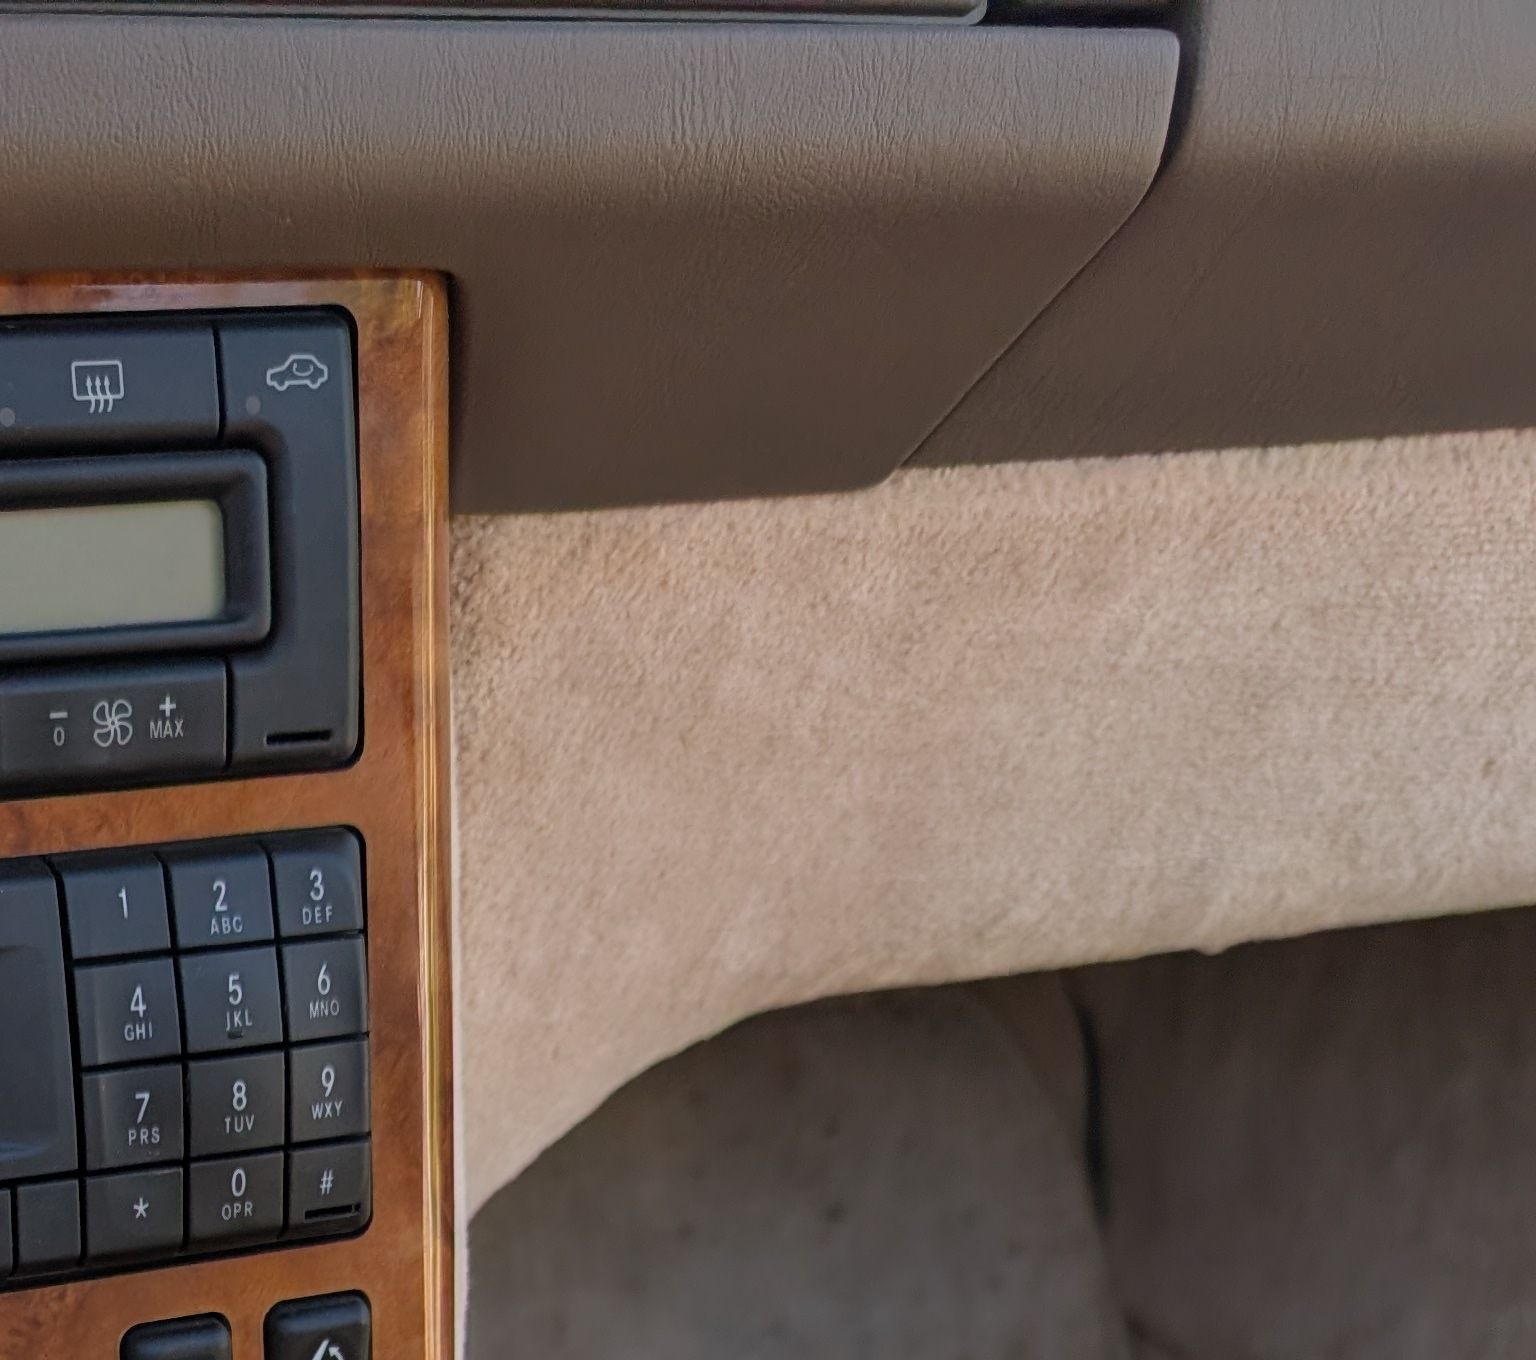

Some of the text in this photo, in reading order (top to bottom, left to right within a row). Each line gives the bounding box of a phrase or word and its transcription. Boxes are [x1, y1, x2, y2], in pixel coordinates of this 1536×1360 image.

[149, 719, 184, 739] MAX
[213, 880, 228, 912] 2
[309, 869, 324, 901] 3
[118, 886, 129, 919] 1
[210, 917, 243, 935] ABC
[302, 906, 333, 925] DEF
[228, 973, 243, 1005] 5
[317, 962, 331, 995] 6
[130, 984, 147, 1018] 4
[309, 1000, 340, 1019] MNO
[124, 1022, 153, 1041] GHI
[225, 1010, 252, 1031] JKL
[321, 1065, 335, 1098] 9
[135, 1092, 150, 1124] 7
[232, 1080, 247, 1111] 8
[311, 1101, 343, 1120] WXY
[128, 1128, 160, 1146] PRS
[225, 1115, 255, 1134] TUV
[231, 1168, 246, 1197] 0
[221, 1201, 253, 1221] OPR
